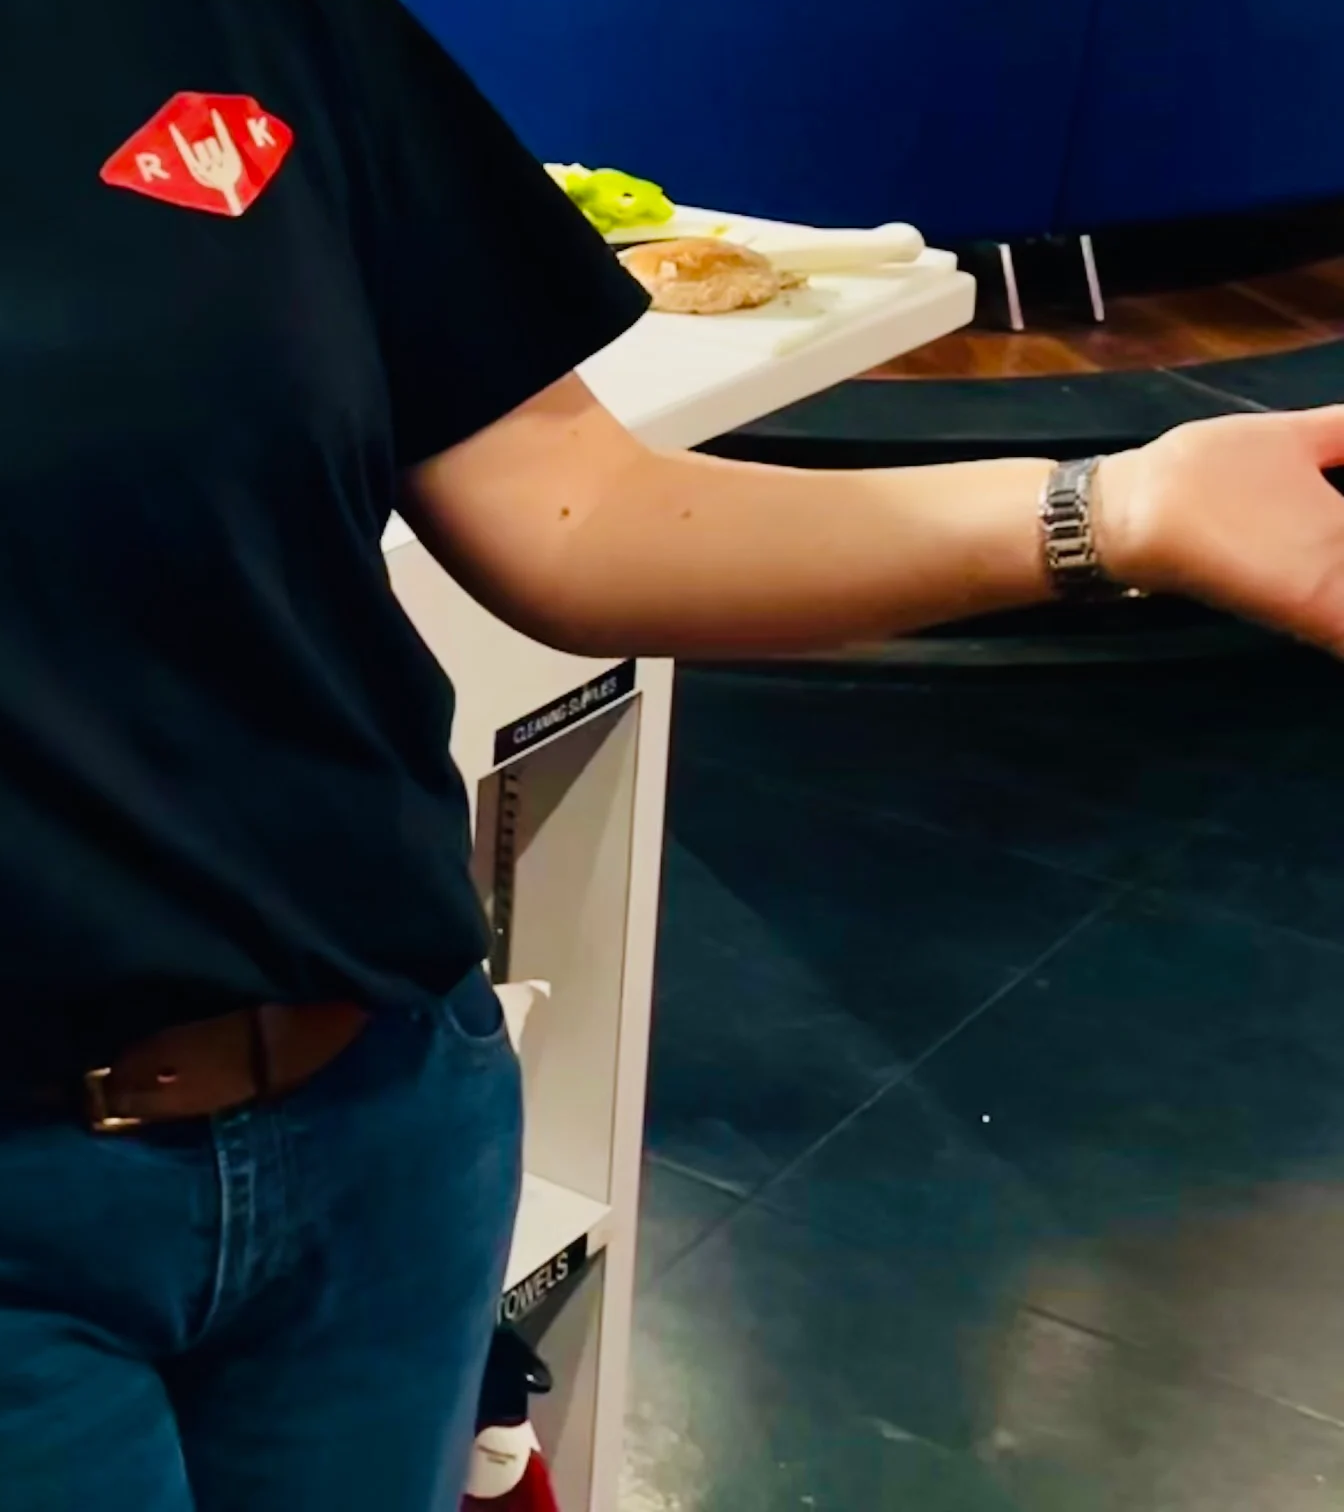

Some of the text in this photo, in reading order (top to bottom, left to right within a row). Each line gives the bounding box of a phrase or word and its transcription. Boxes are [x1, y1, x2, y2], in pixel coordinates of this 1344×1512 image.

[135, 116, 276, 183] R K
[496, 1251, 569, 1326] TOWELS
